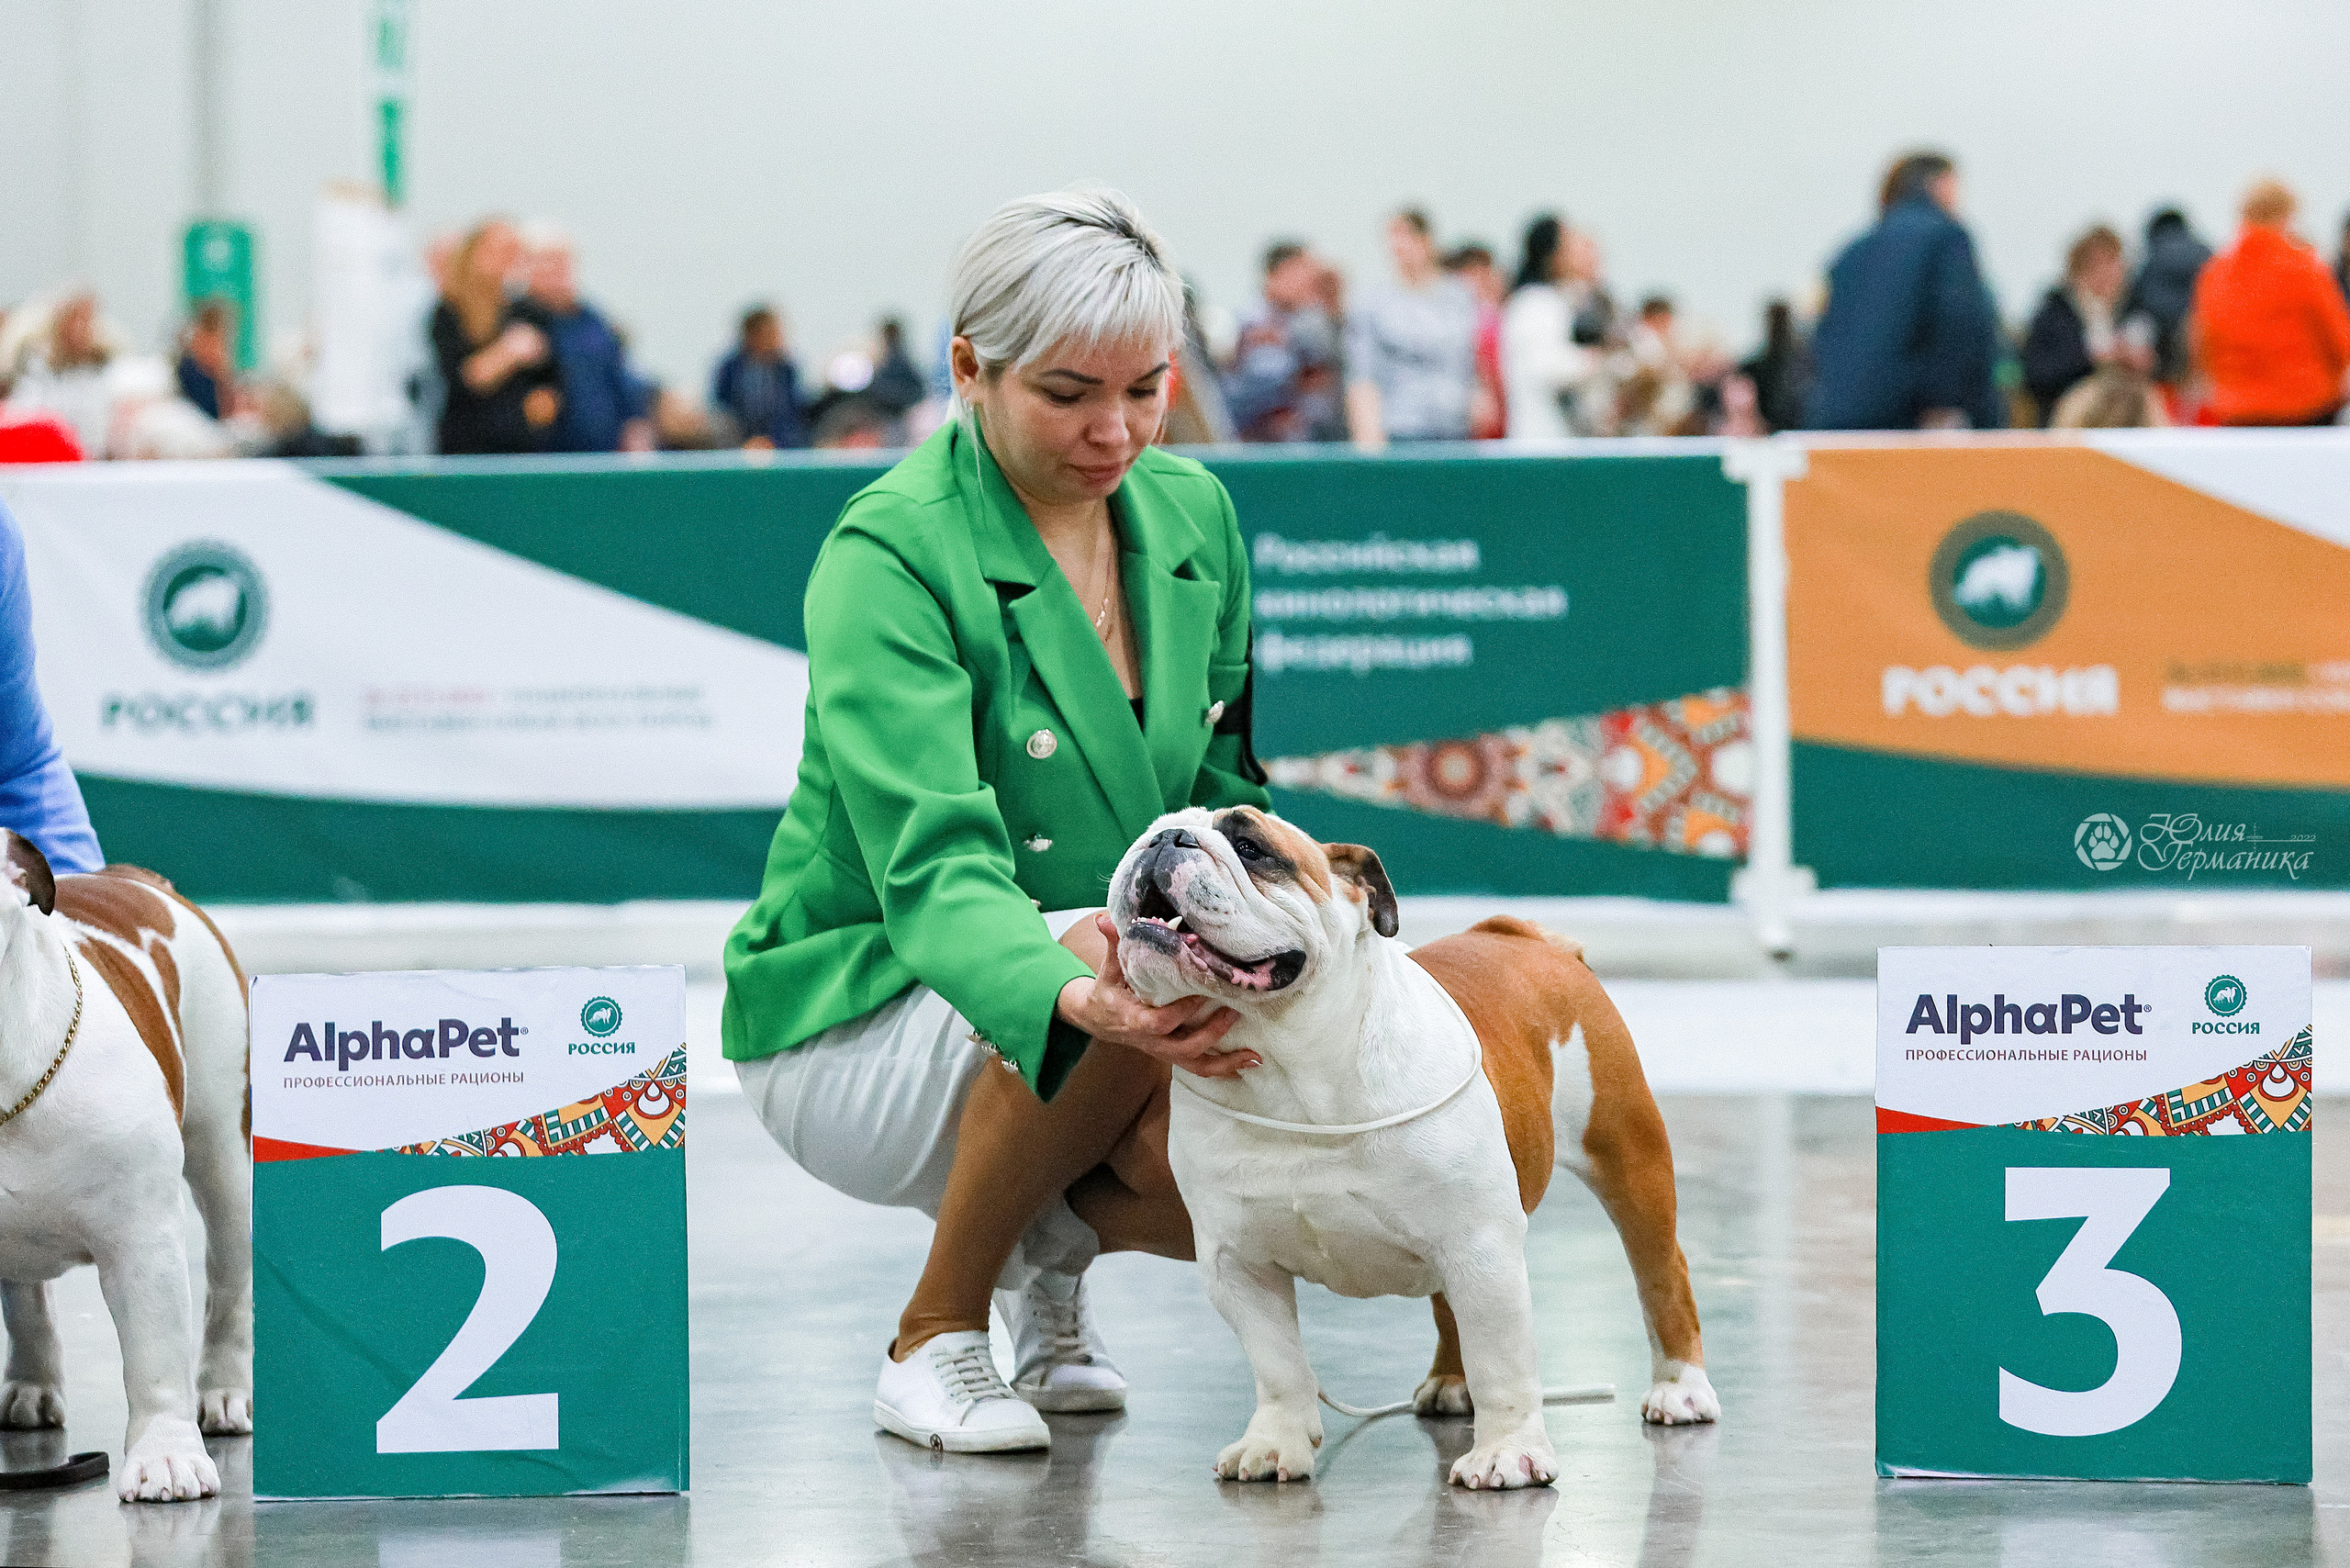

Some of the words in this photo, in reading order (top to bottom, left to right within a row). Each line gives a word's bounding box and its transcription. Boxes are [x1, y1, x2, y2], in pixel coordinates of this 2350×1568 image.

[1883, 664, 2119, 717] РОССИЯ
[101, 687, 315, 736] РОССИЯ
[2192, 1022, 2260, 1035] РОССИЯ
[567, 1042, 635, 1056] РОССИЯ
[1906, 1047, 2068, 1062] ПРОФЕССИОНАЛЬНЫЕ
[2074, 1047, 2147, 1063] РАЦИОНЫ
[284, 1073, 446, 1090] ПРОФЕССИОНАЛЬНЫЕ
[451, 1071, 524, 1088] РАЦИОНЫ
[376, 1184, 559, 1453] 2
[1999, 1167, 2182, 1437] 3
